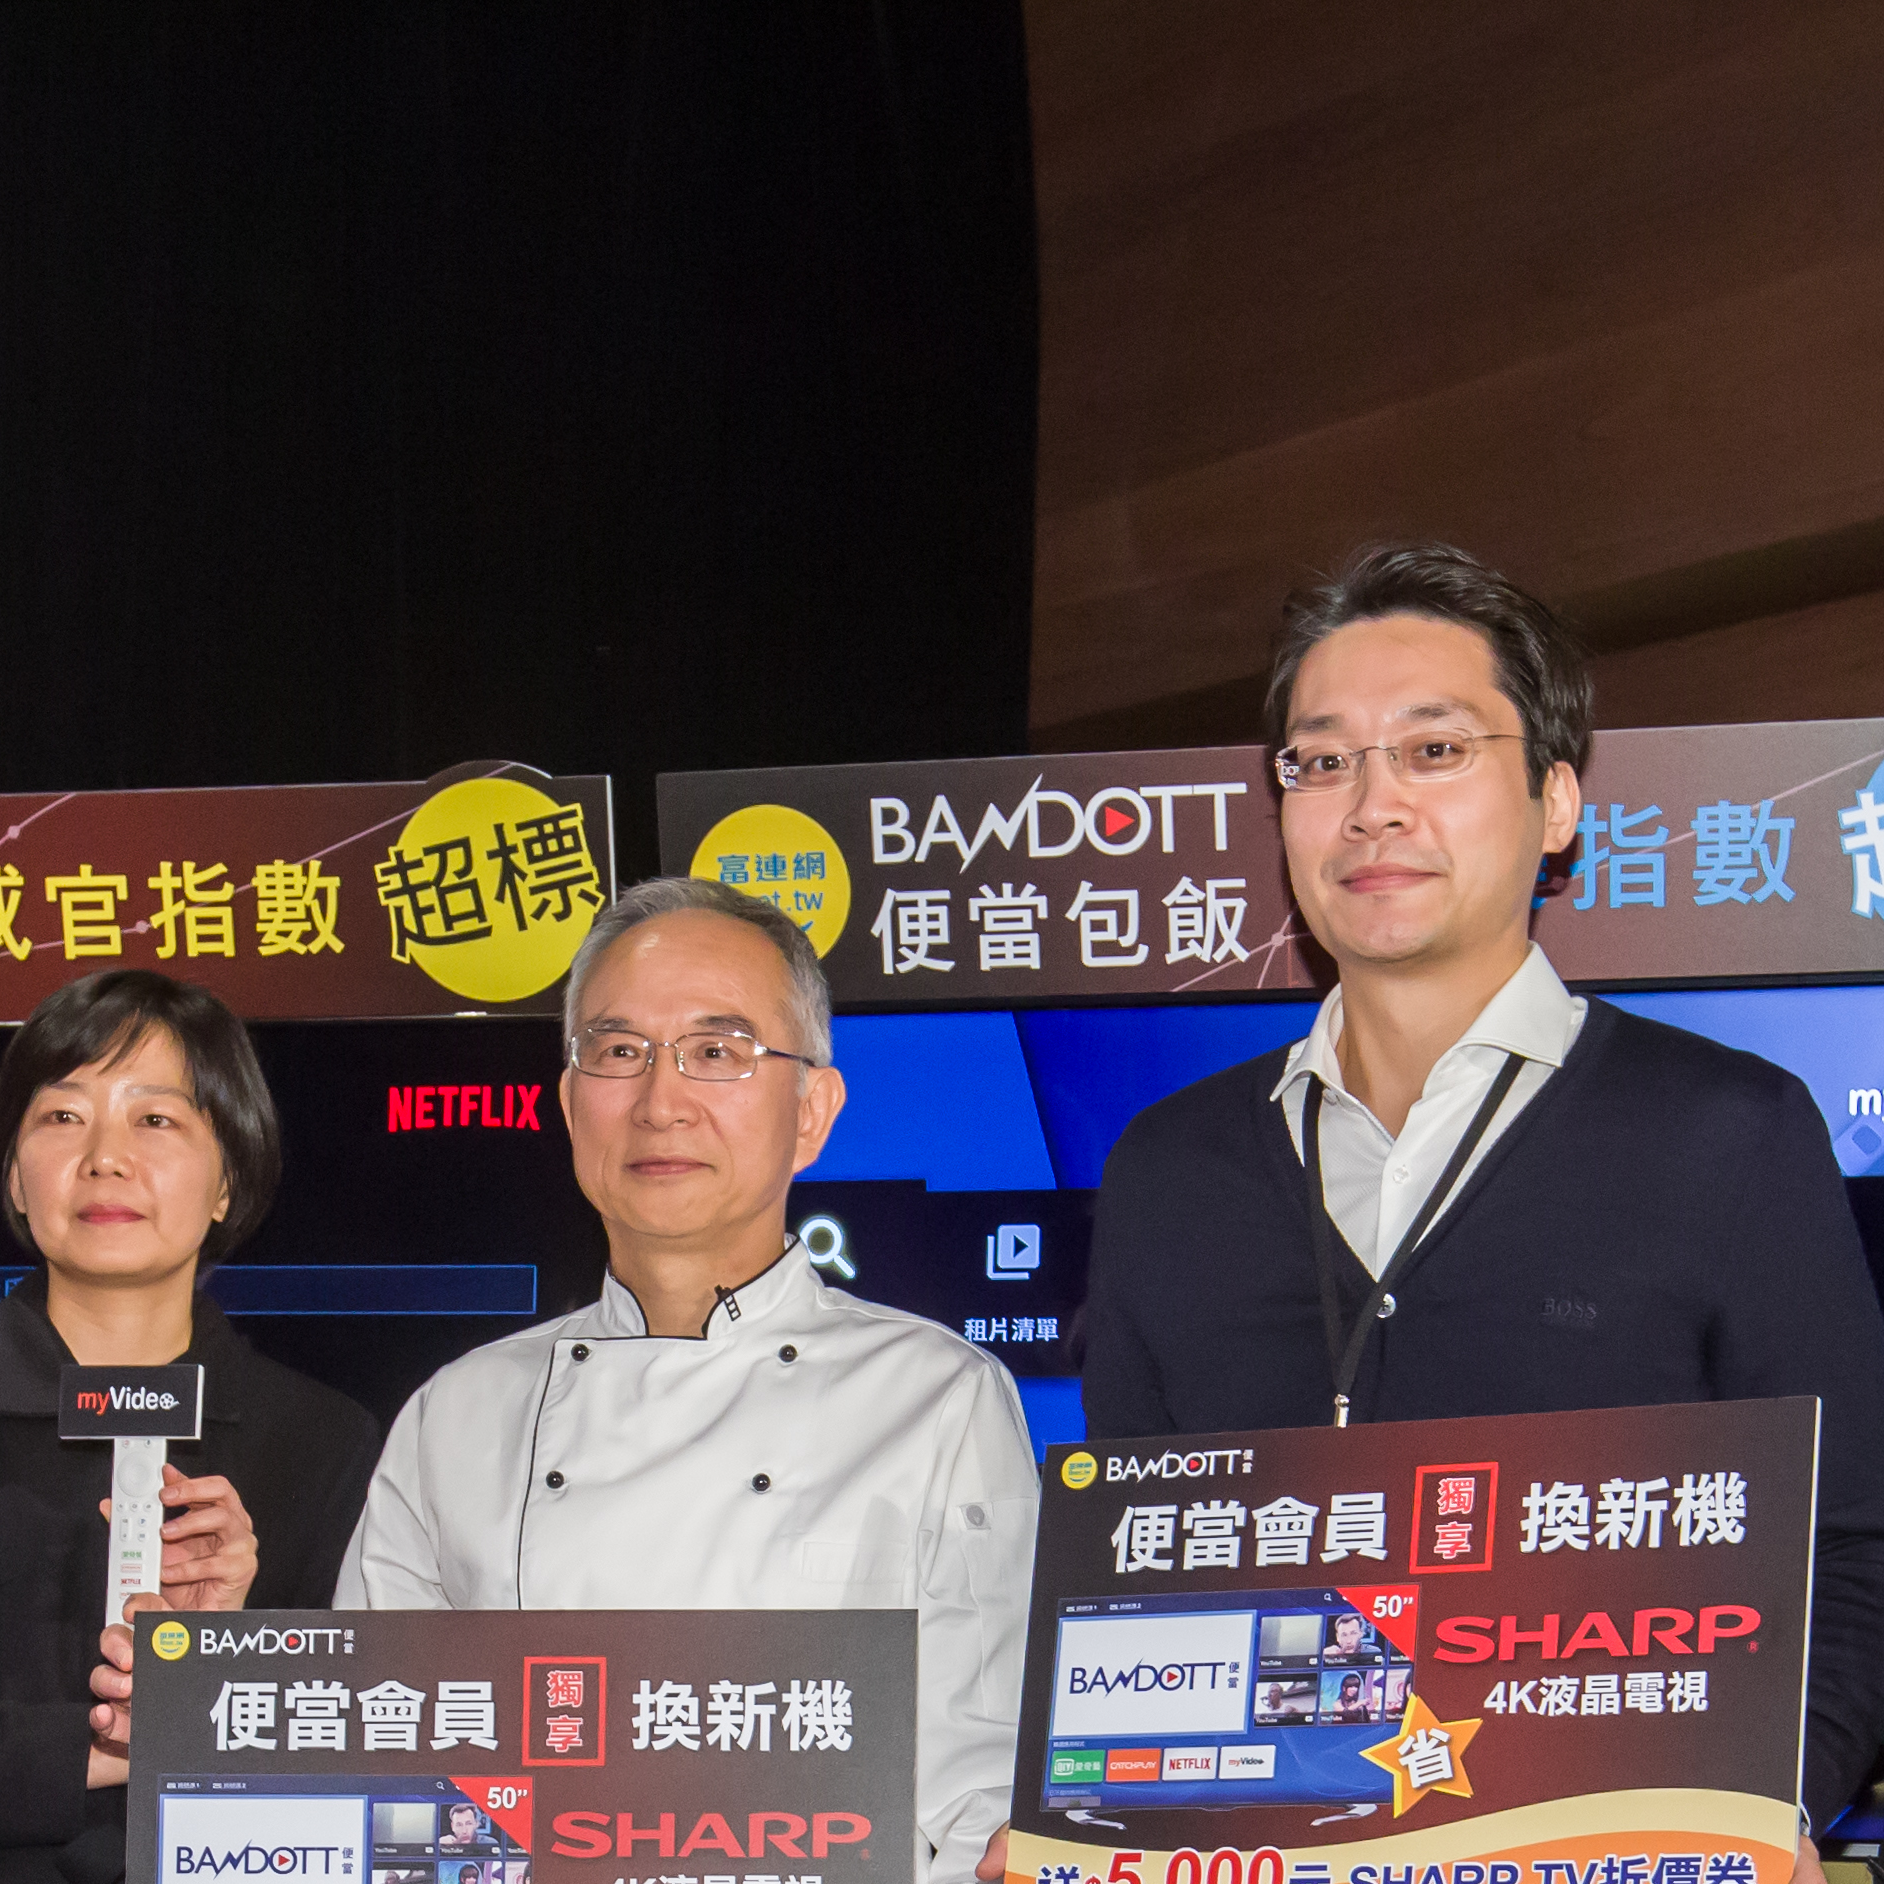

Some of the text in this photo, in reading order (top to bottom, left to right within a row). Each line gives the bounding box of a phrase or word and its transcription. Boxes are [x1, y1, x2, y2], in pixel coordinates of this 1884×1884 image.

[870, 773, 1247, 875] BANDOTT
[374, 803, 604, 964] 超標
[718, 851, 826, 886] 富連網
[871, 874, 1250, 975] 便當包飯
[386, 1085, 540, 1131] NETFLIX
[964, 1317, 1059, 1342] 租片清單
[77, 1386, 180, 1416] myVideo
[1106, 1448, 1241, 1483] BANDOTT
[1110, 1492, 1388, 1575] 便當會員
[1434, 1475, 1475, 1560] 獨享
[1520, 1472, 1748, 1554] 換新機
[200, 1623, 341, 1658] BANDOTT
[1434, 1605, 1762, 1664] SHARP
[1069, 1657, 1226, 1699] BANDOTT
[1484, 1671, 1708, 1718] 4K液晶電視
[210, 1680, 499, 1753] 便當會員
[545, 1670, 585, 1753] 獨享
[632, 1680, 854, 1753] 換新機
[1169, 1757, 1211, 1770] NETFLIX
[1398, 1728, 1453, 1789] 省
[176, 1839, 339, 1880] BANDOTT
[551, 1811, 872, 1860] SHARP
